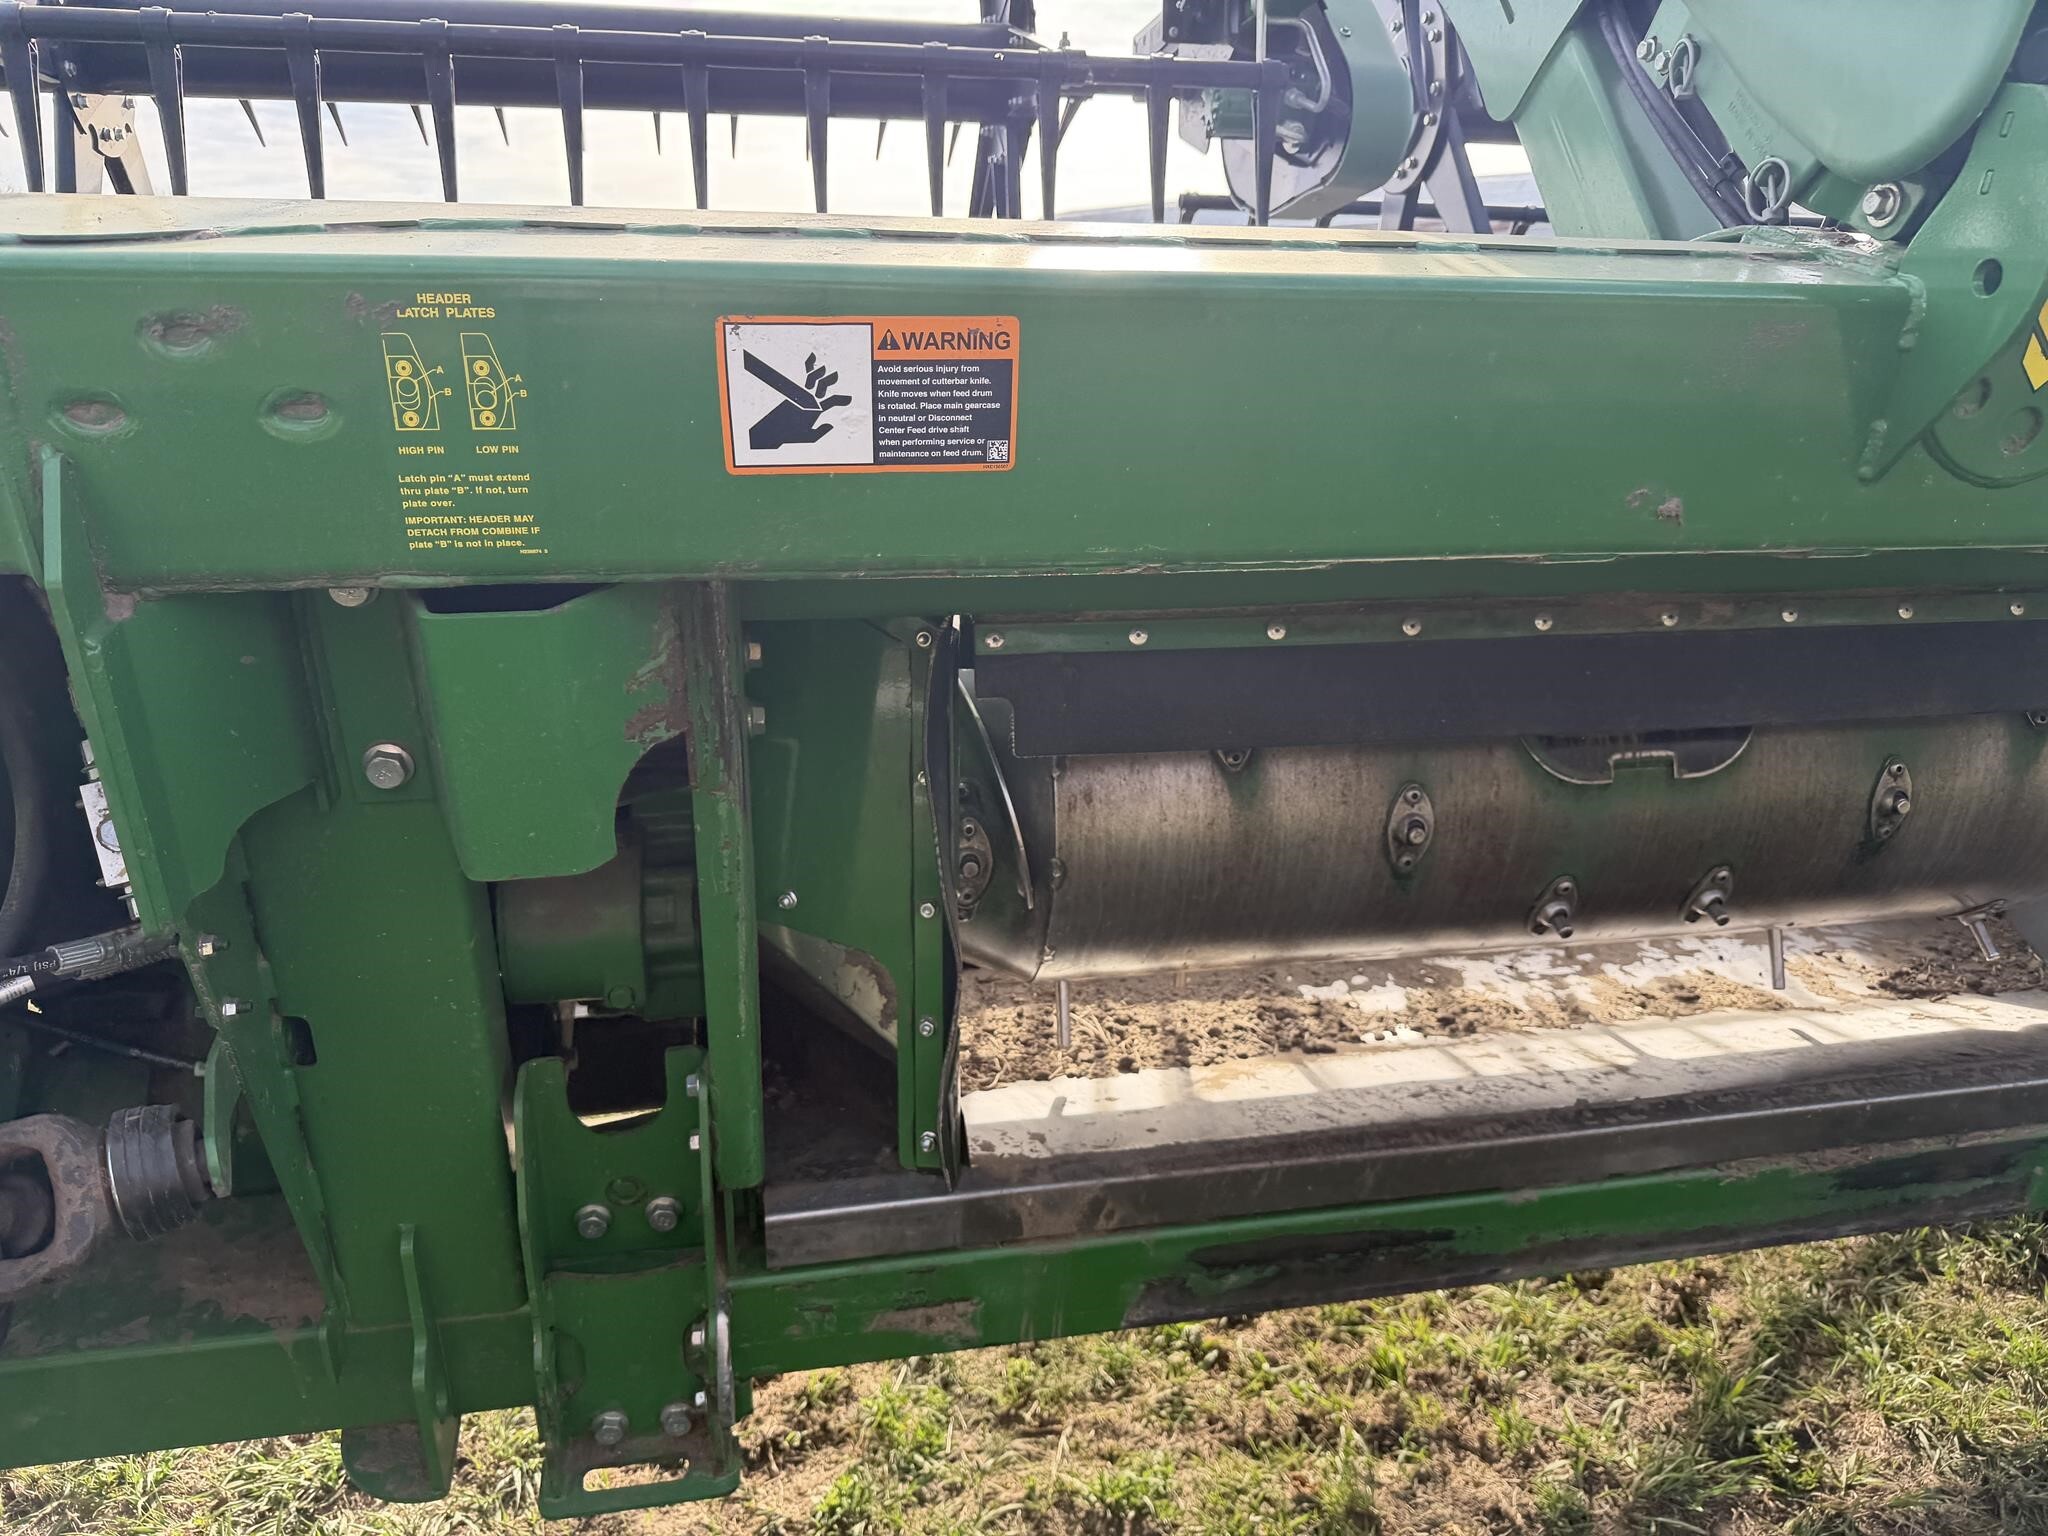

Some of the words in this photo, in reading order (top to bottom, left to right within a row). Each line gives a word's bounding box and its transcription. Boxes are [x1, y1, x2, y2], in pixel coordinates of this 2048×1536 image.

[417, 293, 471, 304] HEADER
[397, 308, 439, 318] LATCH
[446, 308, 495, 318] PLATES
[902, 331, 1010, 350] WARNING
[936, 365, 959, 374] injury
[514, 374, 522, 382] A
[950, 425, 969, 433] shaft
[902, 438, 945, 447] performing
[427, 446, 444, 454] PIN
[430, 475, 445, 484] pin
[424, 487, 449, 496] plate
[403, 500, 427, 509] plate
[405, 516, 466, 524] IMPORTANT:
[469, 515, 511, 523] HEADER
[482, 527, 528, 535] COMBINE
[409, 541, 433, 550] plate
[497, 540, 524, 548] place.
